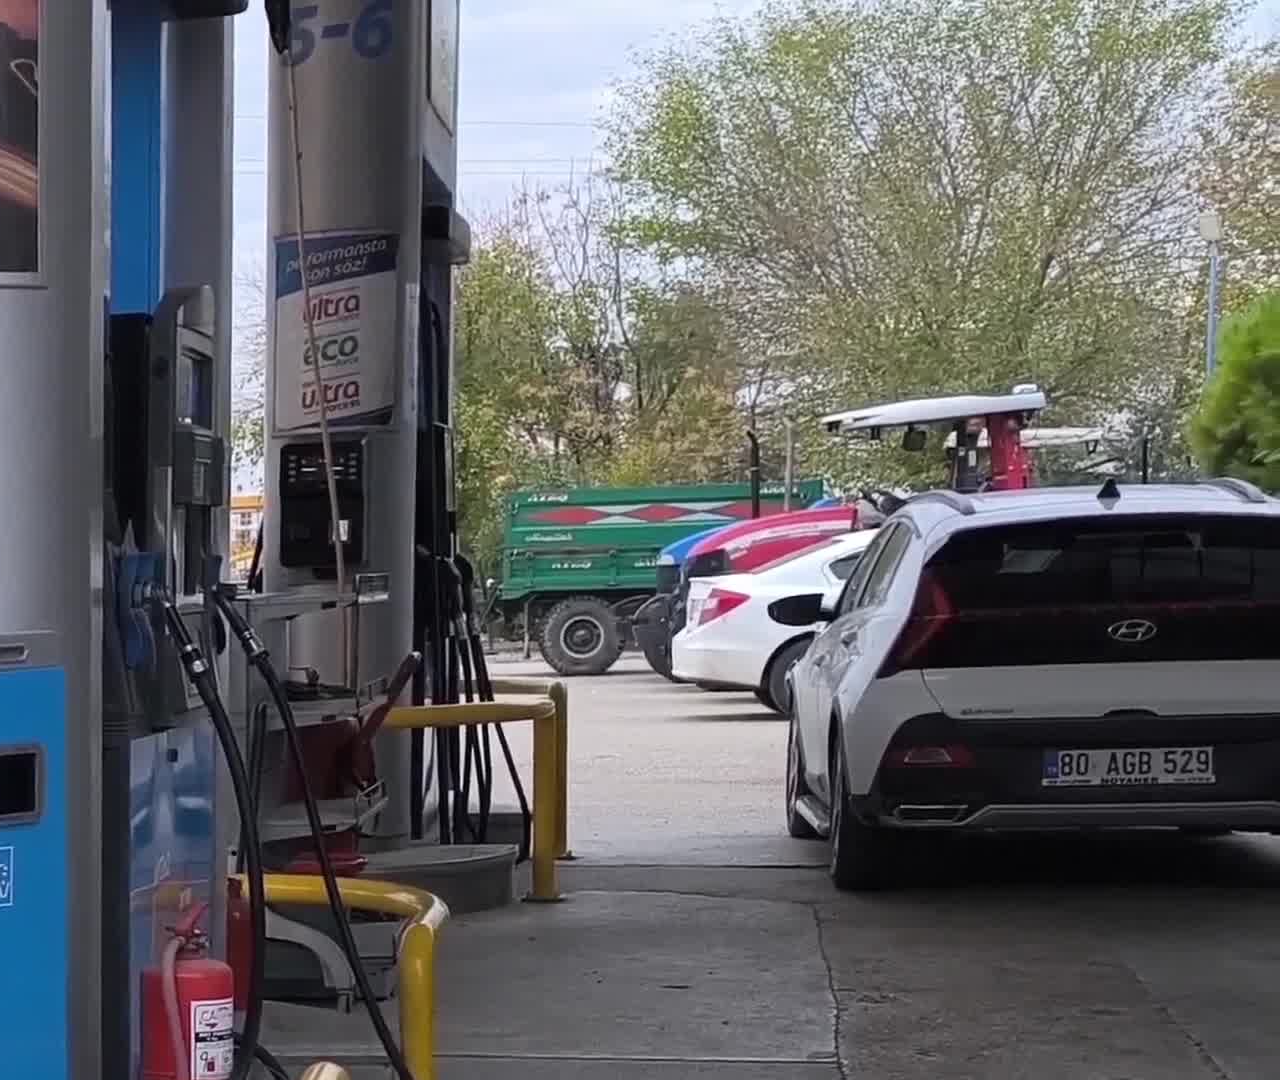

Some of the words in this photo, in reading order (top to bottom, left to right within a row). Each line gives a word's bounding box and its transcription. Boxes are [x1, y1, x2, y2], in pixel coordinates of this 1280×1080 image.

[302, 294, 360, 321] ultra
[302, 380, 360, 409] utra
[1060, 752, 1089, 776] 80
[1106, 751, 1152, 775] AGB
[1163, 750, 1209, 775] 529
